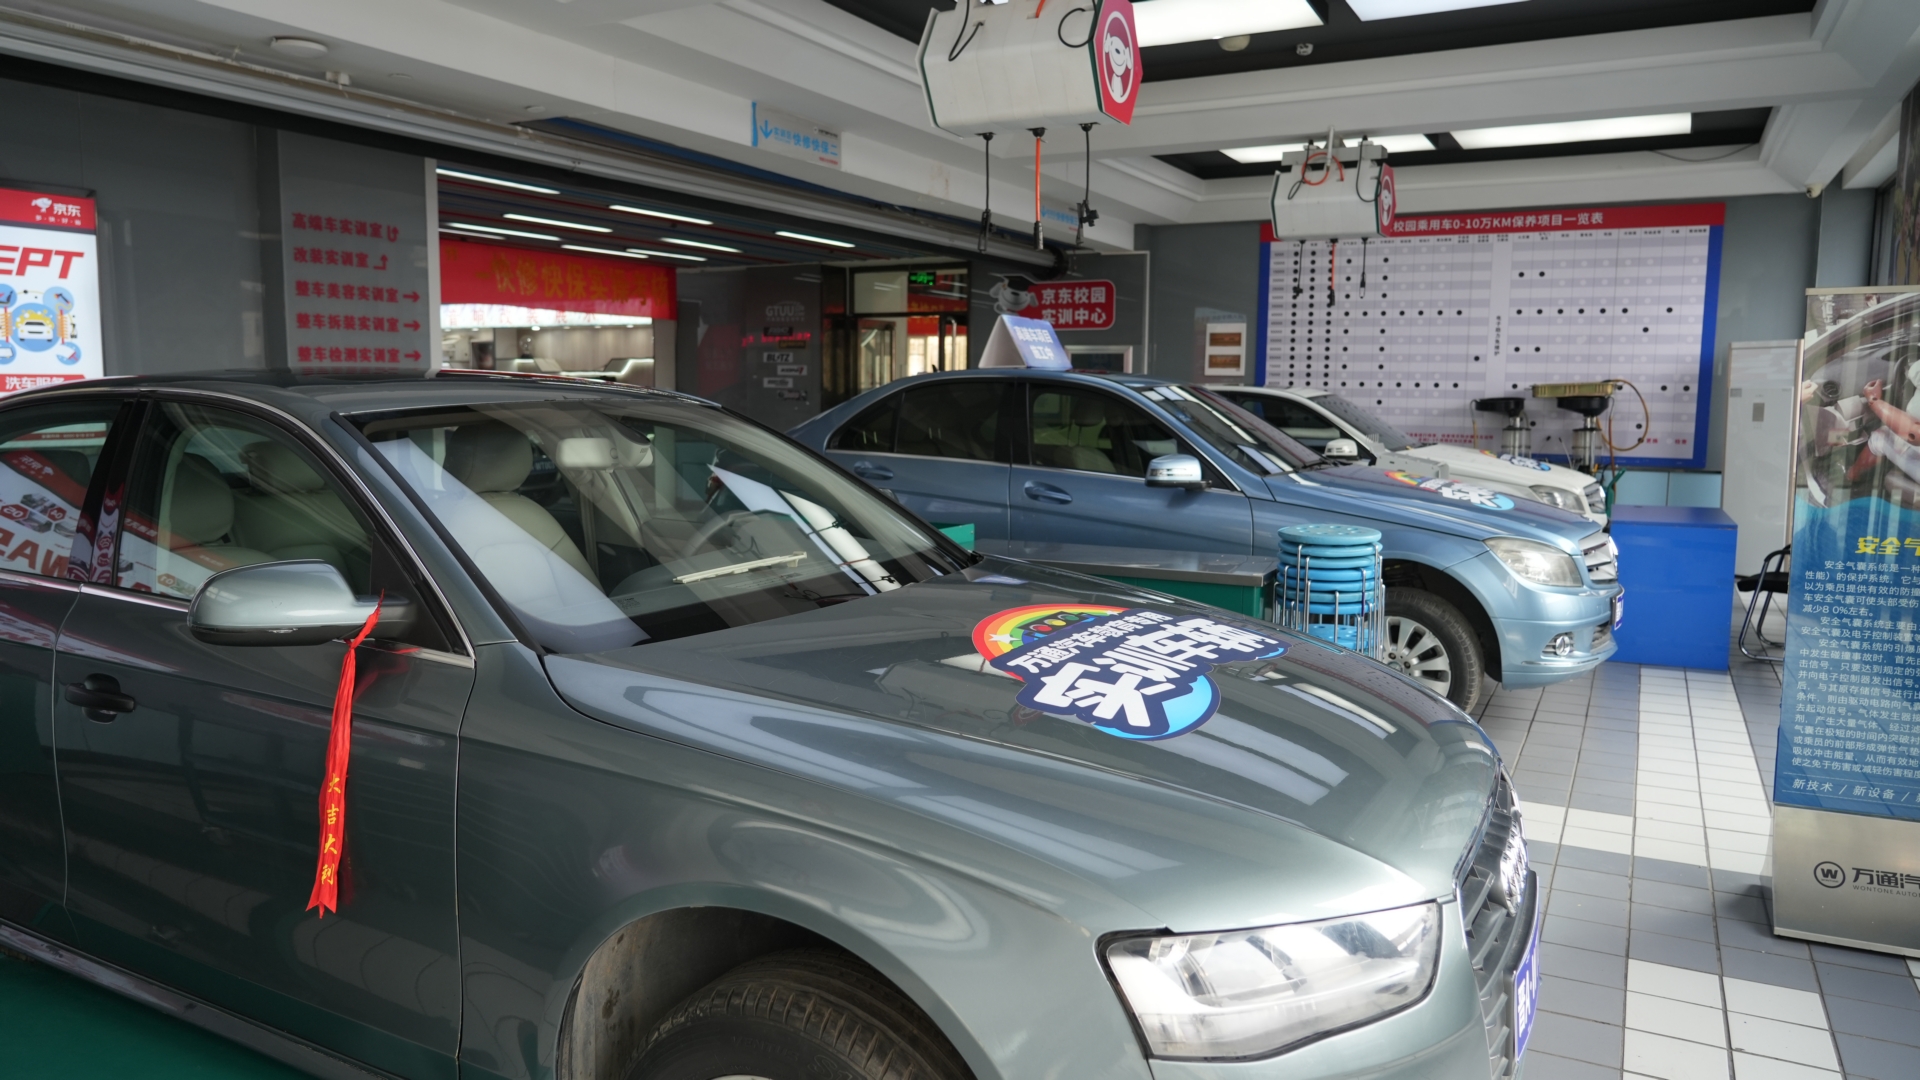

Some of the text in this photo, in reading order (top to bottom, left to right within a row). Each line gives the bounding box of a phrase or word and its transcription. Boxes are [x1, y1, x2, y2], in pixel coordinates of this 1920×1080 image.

[53, 203, 81, 217] 京东
[292, 212, 383, 239] 高端车实训室
[1390, 212, 1604, 232] 校园乘用车0-10万KM保养项目一览表
[293, 246, 369, 269] 改装实训室
[295, 280, 399, 304] 整车美容实训室
[1041, 286, 1107, 305] 京东校园
[296, 312, 400, 333] 整车拆装实训室
[1041, 307, 1107, 326] 实训中心
[297, 345, 400, 364] 整车检测实训室
[1855, 535, 1920, 557] 安全气
[1820, 616, 1920, 631] 安全气囊系统主要由
[1033, 618, 1280, 727] 实训车辆
[1792, 778, 1834, 793] 新技术
[1852, 785, 1896, 800] 新设备
[321, 773, 341, 885] 大吉大利
[1852, 867, 1920, 890] 万通汽
[1852, 884, 1920, 898] WONTONE AUTO
